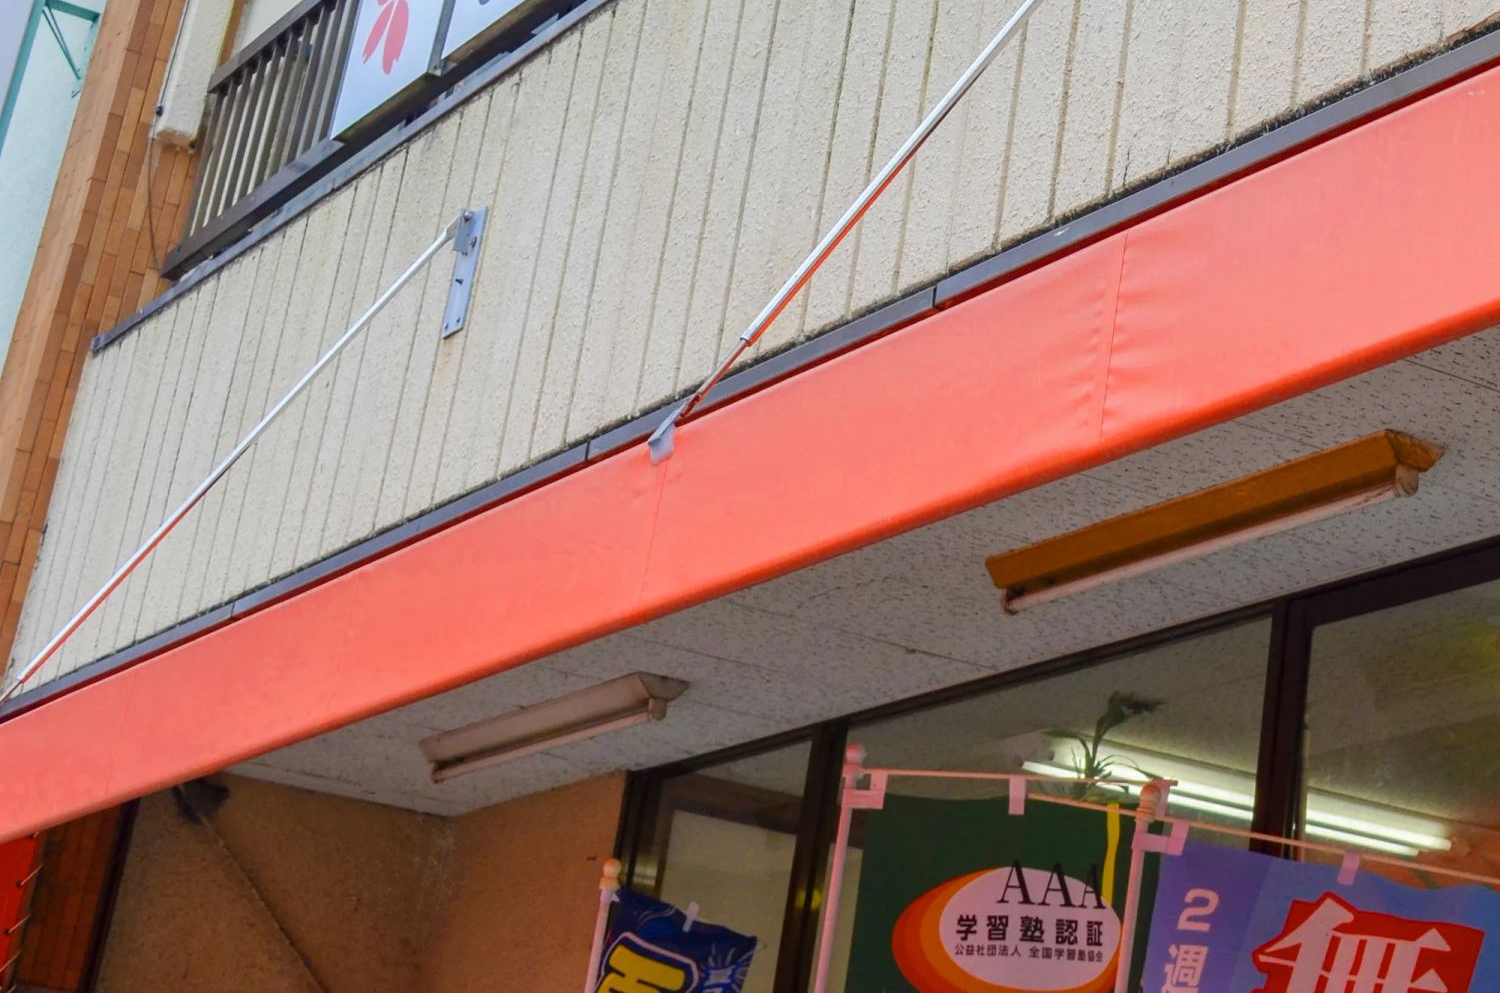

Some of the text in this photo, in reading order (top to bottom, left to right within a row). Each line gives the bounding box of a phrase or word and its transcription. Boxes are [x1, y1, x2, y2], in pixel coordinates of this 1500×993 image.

[996, 859, 1107, 910] AAA
[955, 914, 1104, 947] 学習塾認証
[954, 944, 1022, 958] 公益社団法人
